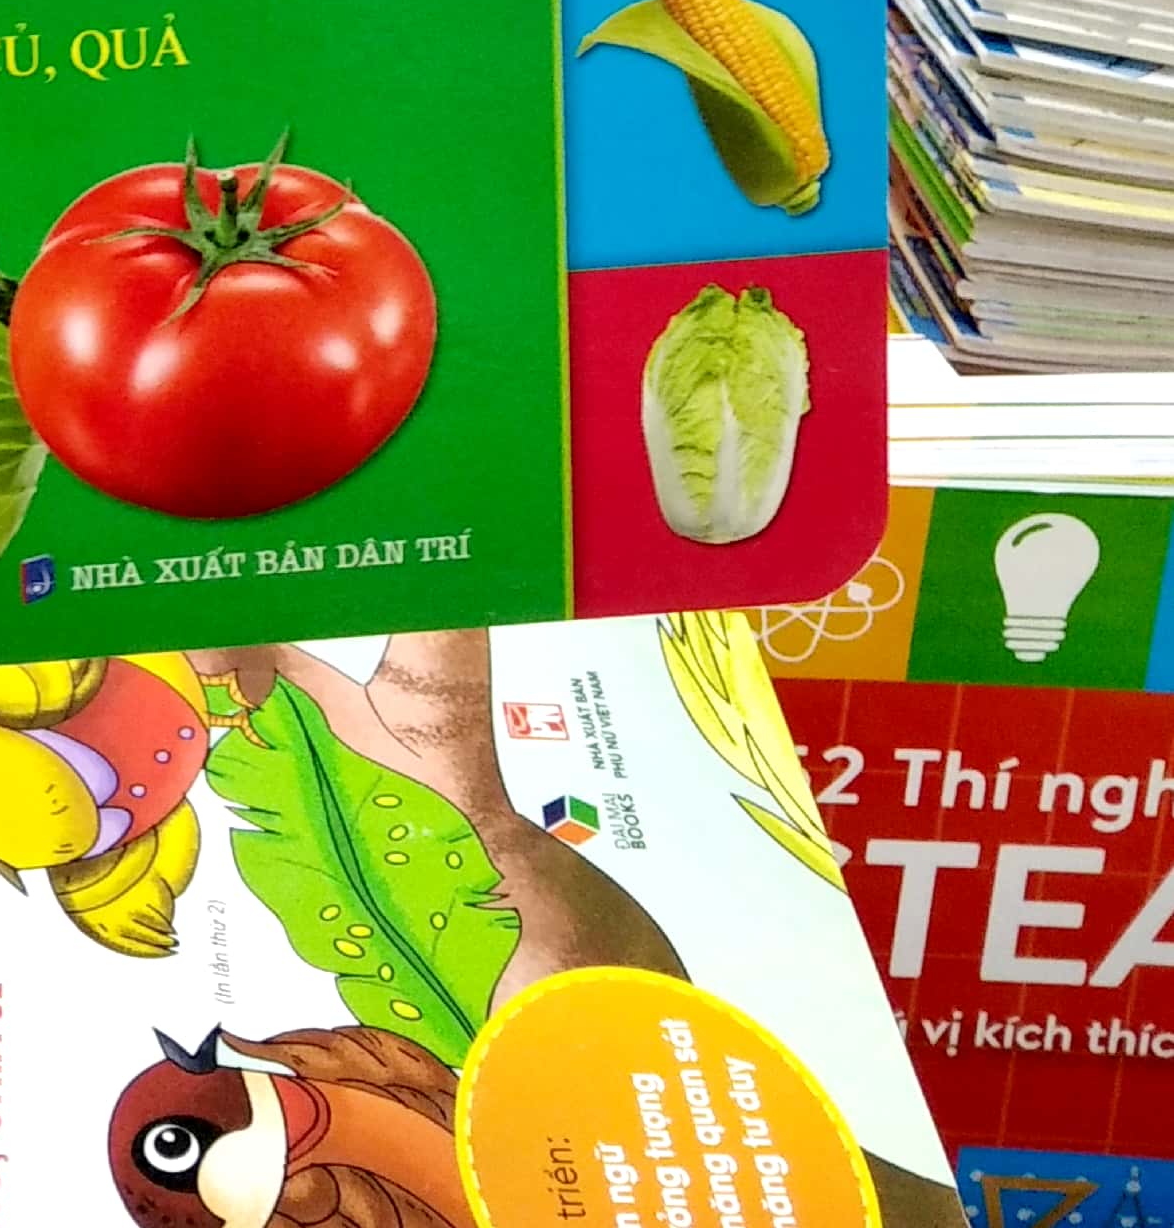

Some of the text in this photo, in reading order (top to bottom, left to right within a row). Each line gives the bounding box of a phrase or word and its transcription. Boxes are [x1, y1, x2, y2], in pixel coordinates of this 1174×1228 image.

[69, 12, 191, 83] QUẢ
[70, 527, 474, 592] NHÀ XUẤT BẢN DÂN TRÍ
[794, 745, 1174, 834] 2 Thí ngh
[617, 794, 648, 851] BOOKS
[830, 838, 1174, 989] TEA
[659, 1017, 699, 1064] sát
[921, 1008, 964, 1058] vị
[973, 1009, 1073, 1054] kích
[1087, 1017, 1174, 1060] thíc
[679, 1068, 726, 1147] quan
[724, 1054, 763, 1113] duy
[630, 1072, 692, 1228] ởng tượng
[741, 1115, 774, 1149] tư
[594, 1140, 639, 1205] ngữ
